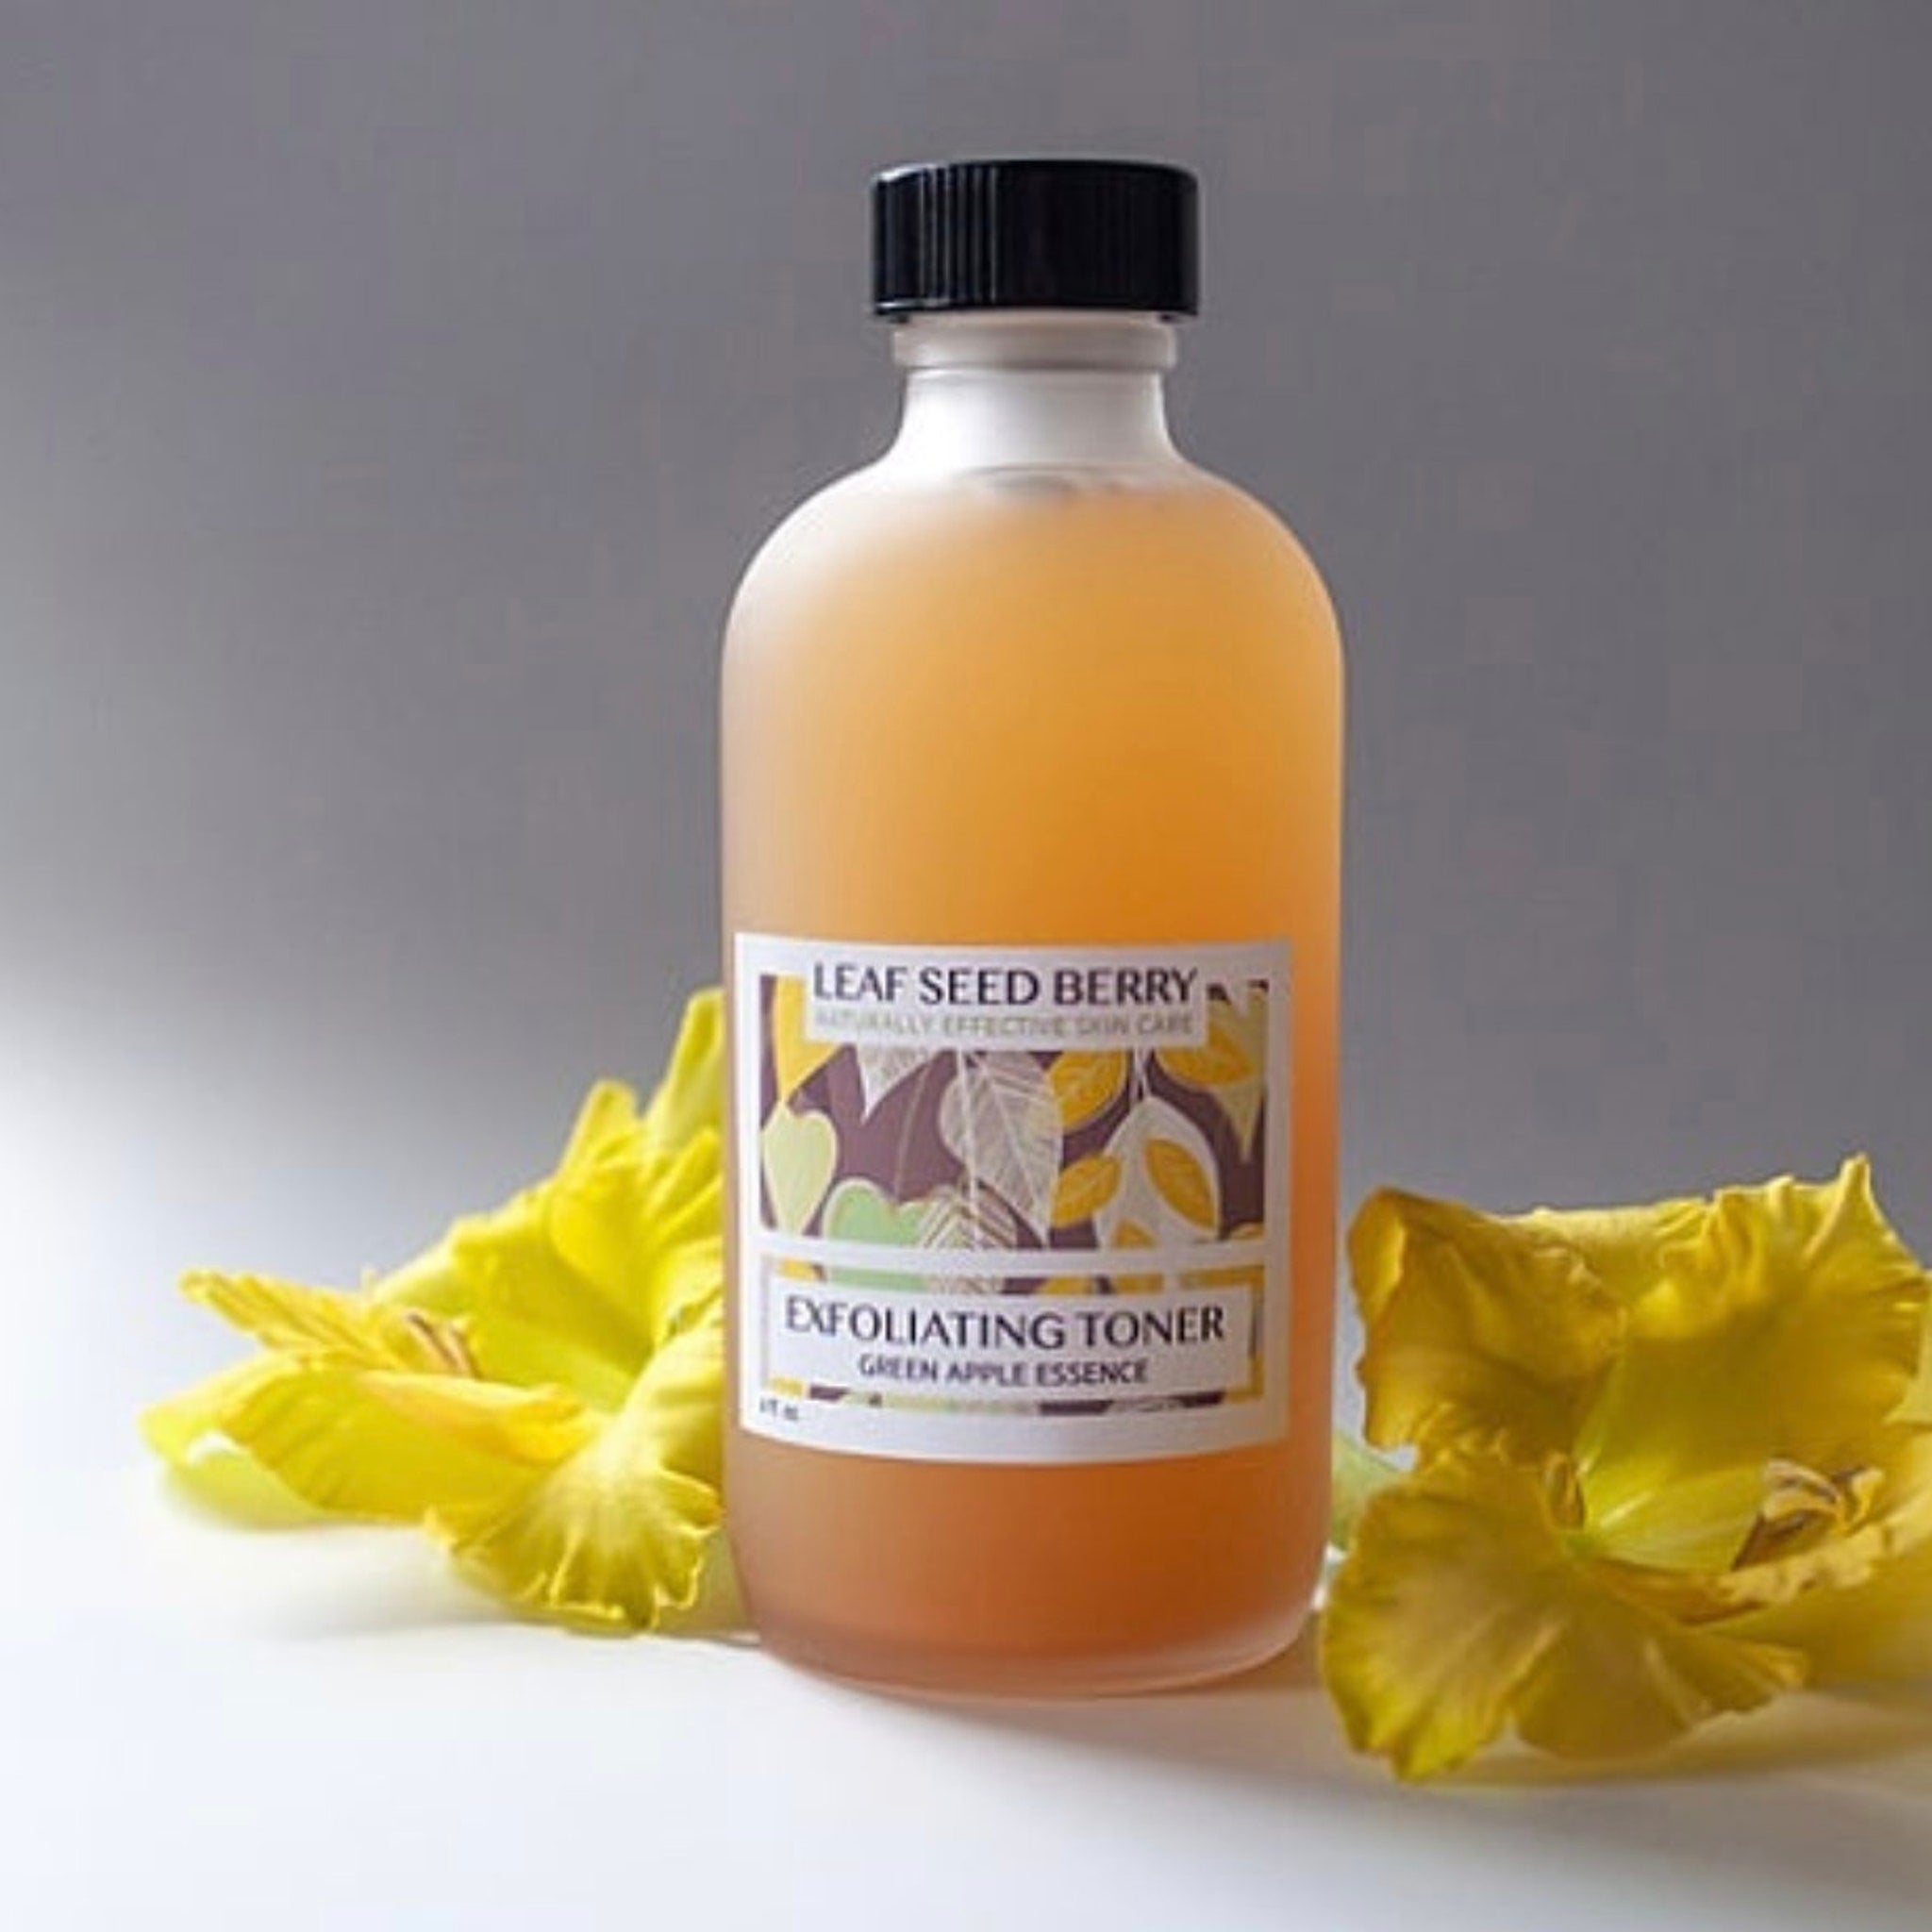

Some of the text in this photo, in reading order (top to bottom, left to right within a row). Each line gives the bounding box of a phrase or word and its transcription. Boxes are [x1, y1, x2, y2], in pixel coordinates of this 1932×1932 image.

[813, 960, 1199, 1007] LEAF SEED BERRY
[942, 1014, 1069, 1038] EFFECTIVE
[1078, 1015, 1130, 1037] SKIN
[1137, 1012, 1194, 1036] CARE
[785, 1294, 1224, 1350] EXFOLIATING TONER
[858, 1353, 1150, 1388] GREEN APPLE ESSENCE
